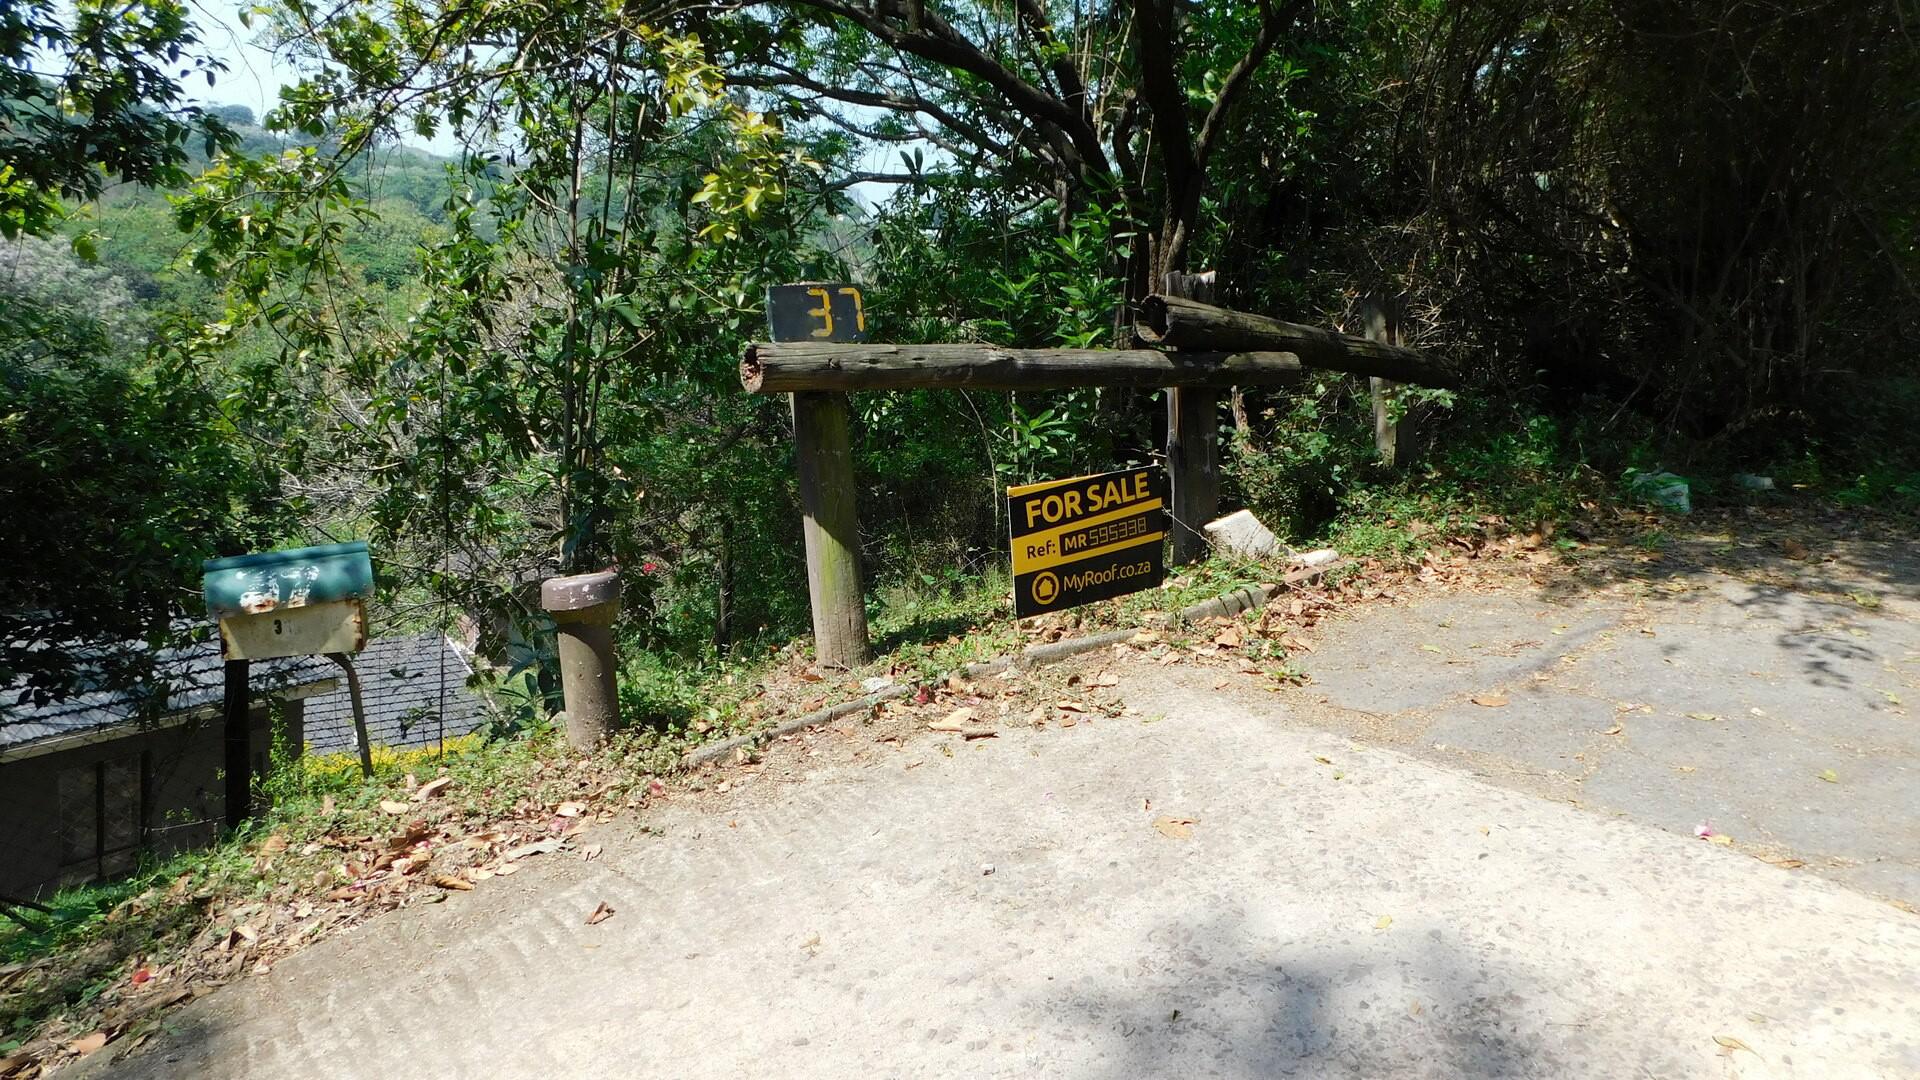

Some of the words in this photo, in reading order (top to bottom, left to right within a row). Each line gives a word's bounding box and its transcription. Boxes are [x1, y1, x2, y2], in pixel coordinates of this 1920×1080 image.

[807, 287, 864, 337] 37
[1025, 491, 1083, 528] FOR
[1087, 472, 1150, 512] SALE
[1027, 540, 1057, 559] Ref:
[1063, 561, 1151, 592] MyRoof.co.za
